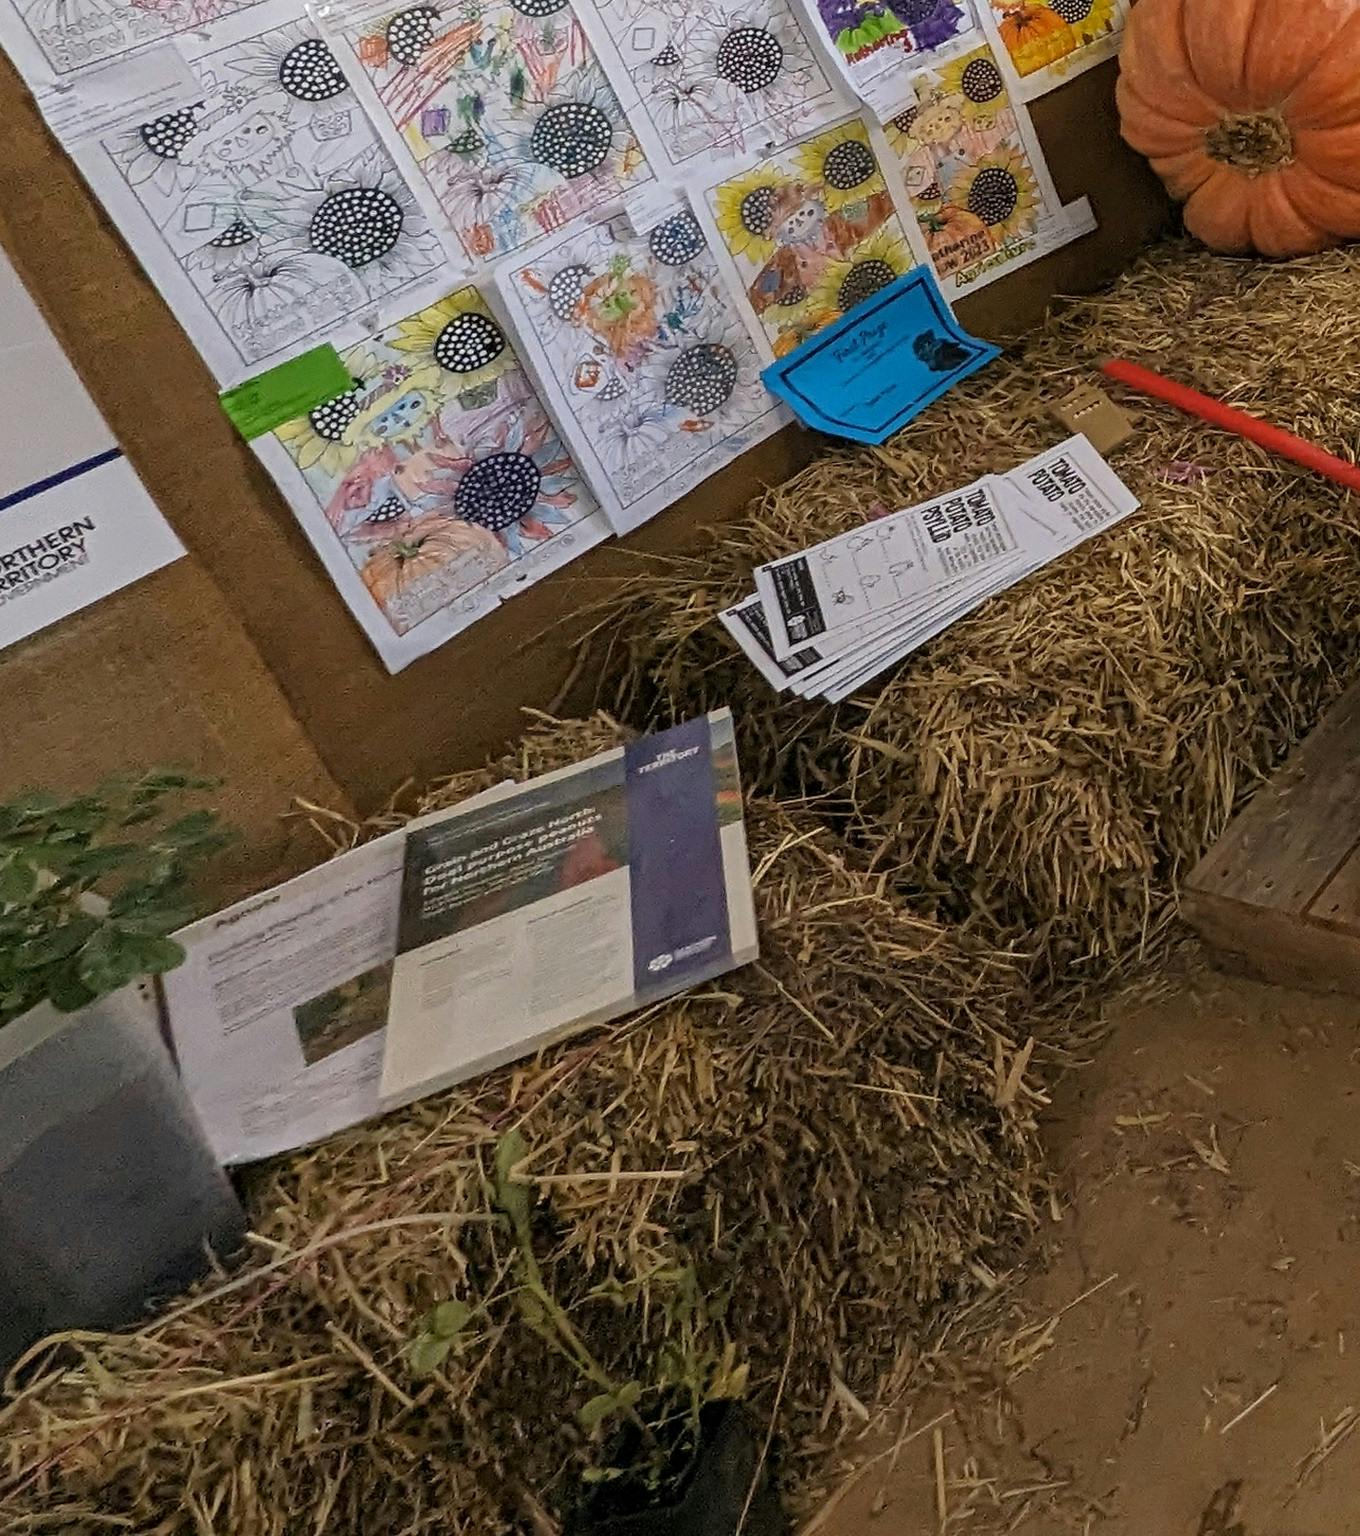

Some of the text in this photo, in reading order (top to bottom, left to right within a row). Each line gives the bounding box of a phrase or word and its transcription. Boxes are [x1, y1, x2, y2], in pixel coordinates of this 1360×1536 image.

[1028, 468, 1065, 503] POTATO
[1048, 457, 1087, 495] TOMATO
[943, 496, 973, 533] POTATO
[966, 488, 996, 527] TOMATO
[451, 851, 523, 885] Northern
[526, 825, 595, 857] Australia
[468, 839, 534, 871] purpose
[470, 840, 499, 859] and
